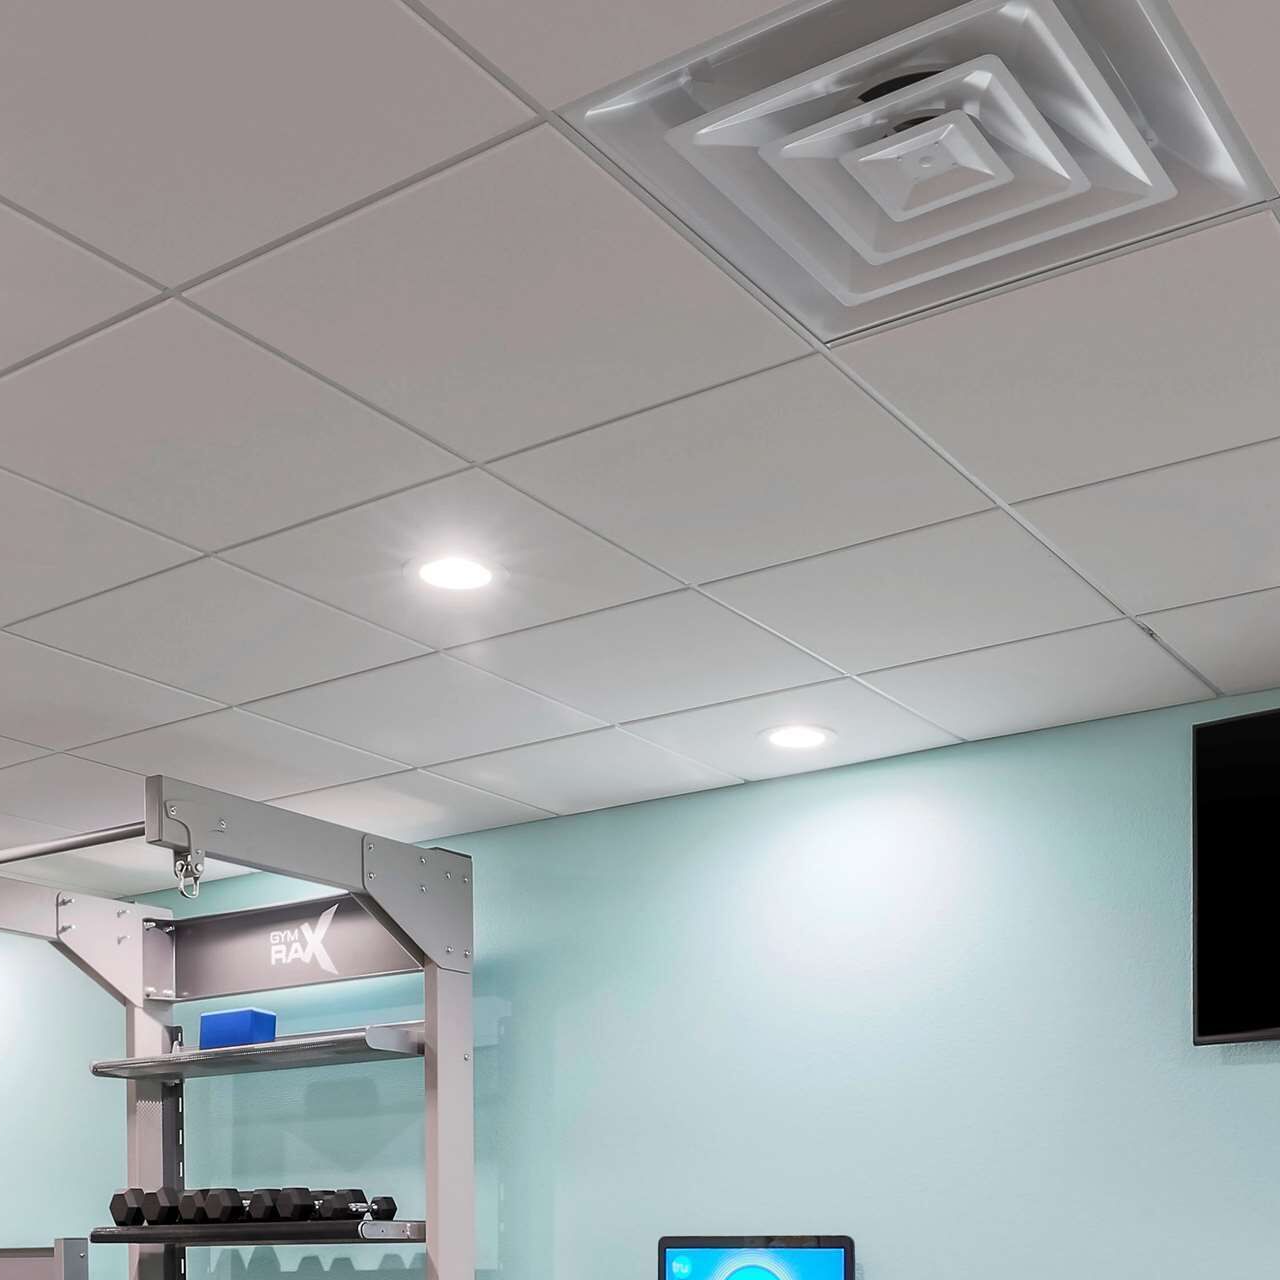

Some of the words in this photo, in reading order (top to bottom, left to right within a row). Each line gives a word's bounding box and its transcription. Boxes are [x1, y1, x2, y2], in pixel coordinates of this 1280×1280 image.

[270, 928, 299, 944] GYM
[271, 903, 339, 975] RAX
[672, 1260, 689, 1273] tru
